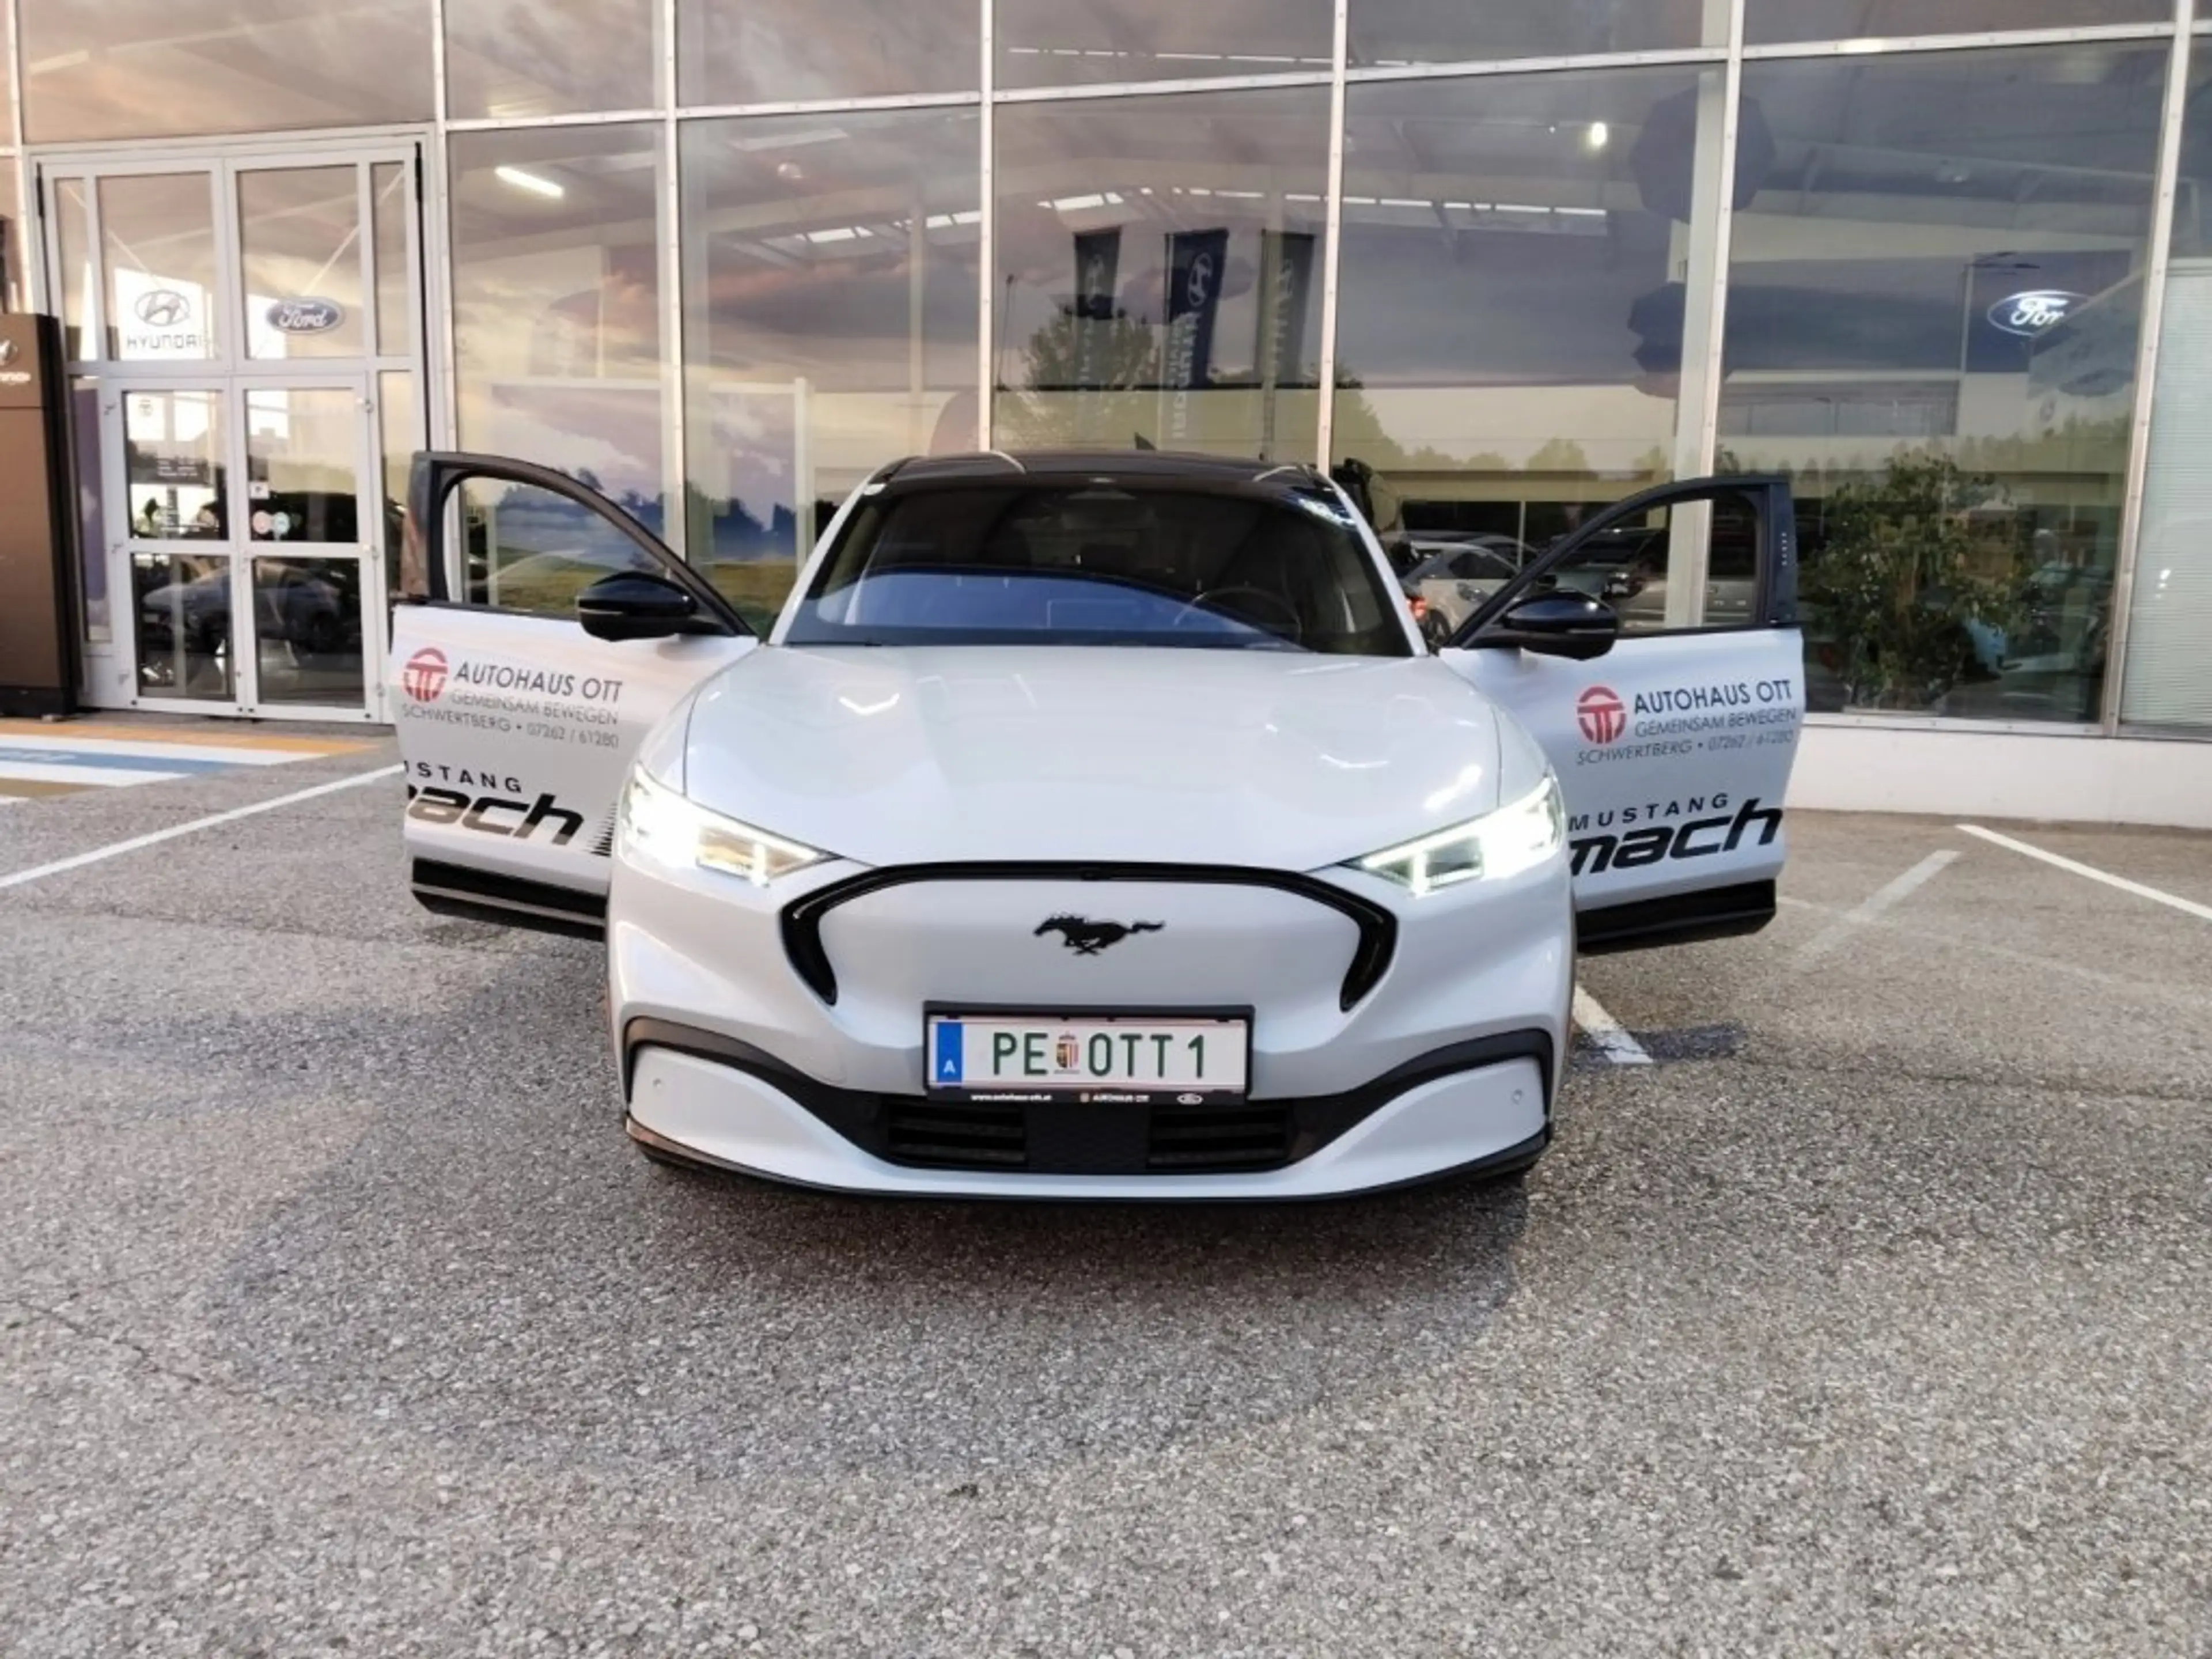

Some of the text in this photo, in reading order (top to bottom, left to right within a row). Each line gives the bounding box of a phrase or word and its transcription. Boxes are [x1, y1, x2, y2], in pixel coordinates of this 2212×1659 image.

[278, 303, 327, 329] Ford
[2010, 297, 2069, 326] For
[126, 333, 203, 349] HYUNDAI
[453, 661, 623, 703] AUTOHAUS OTT
[450, 690, 540, 715] GEMEINSAM
[1634, 680, 1791, 714] AUTOHAUS OTT
[403, 704, 512, 732] SCHWERTBERG
[1634, 714, 1727, 738] GEMEINSAM
[403, 759, 522, 793] STANG
[408, 785, 584, 845] ach
[1568, 793, 1729, 832] MUSTANG
[942, 1059, 956, 1074] A
[993, 1032, 1049, 1075] PE
